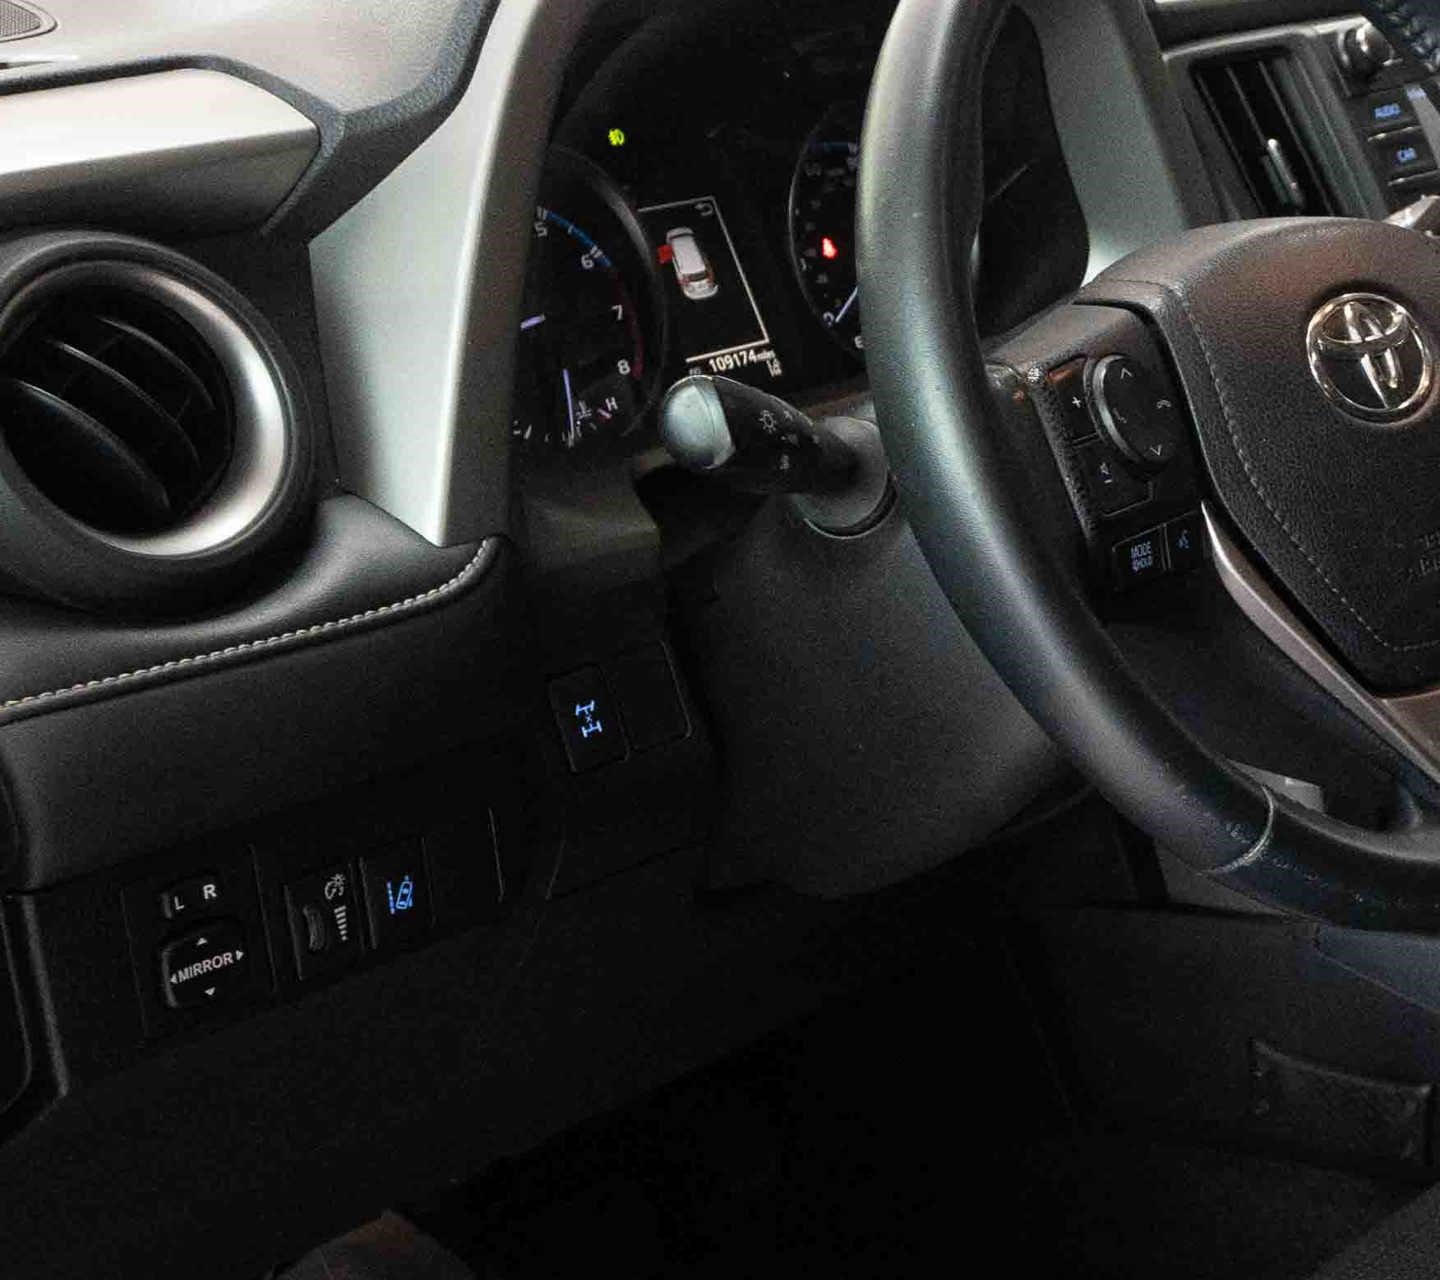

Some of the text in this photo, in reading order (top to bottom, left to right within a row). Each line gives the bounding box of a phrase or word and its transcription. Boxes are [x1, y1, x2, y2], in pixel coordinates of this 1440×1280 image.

[580, 253, 595, 270] 6
[611, 304, 624, 321] 7
[616, 358, 631, 376] 8
[708, 348, 758, 374] 109174
[173, 883, 218, 911] L R
[177, 951, 235, 984] MIRROR
